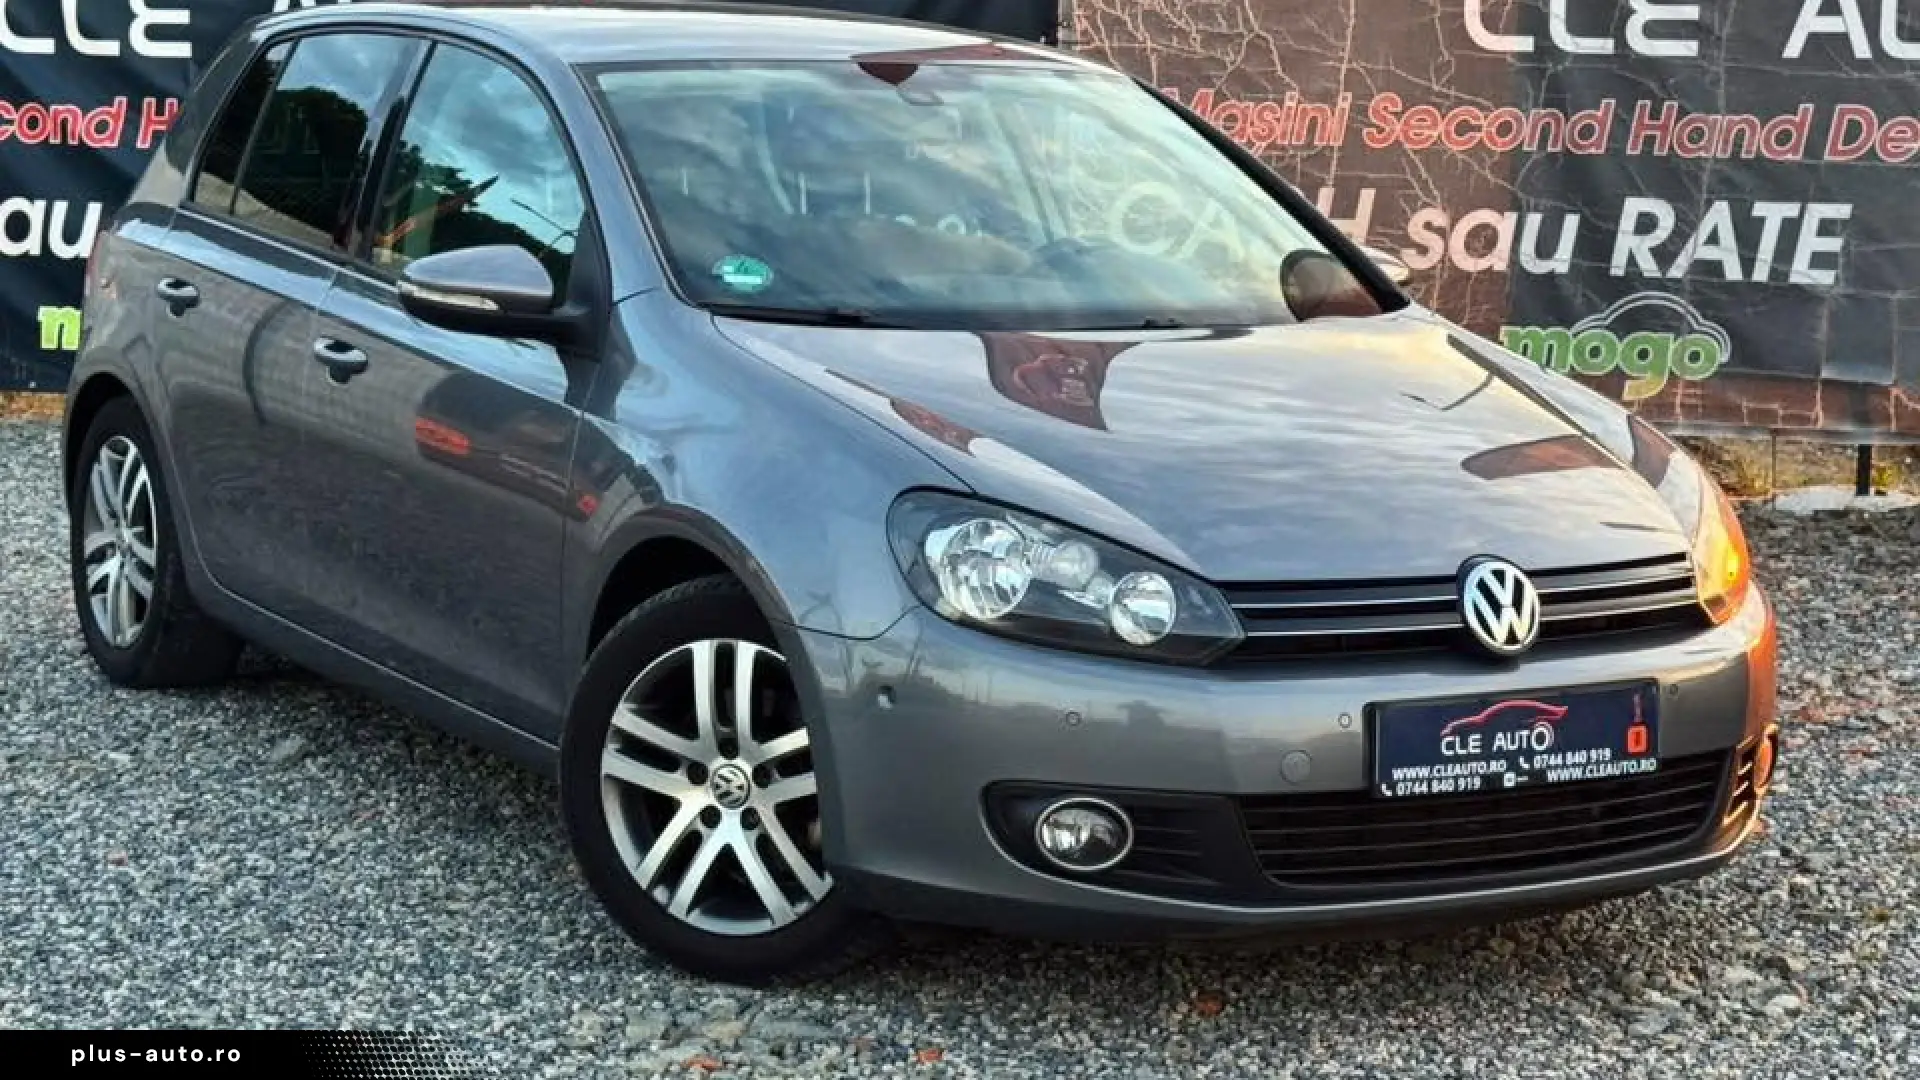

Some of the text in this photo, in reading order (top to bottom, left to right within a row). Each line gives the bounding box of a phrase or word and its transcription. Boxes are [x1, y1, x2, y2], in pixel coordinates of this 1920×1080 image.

[1464, 0, 1699, 57] CLE
[1363, 92, 1616, 155] Second
[1626, 100, 1814, 161] Hand
[1823, 103, 1920, 163] De
[0, 195, 104, 259] au
[1400, 205, 1581, 276] sau
[1608, 196, 1853, 286] RATE
[1500, 324, 1723, 402] mogo
[1463, 561, 1540, 653] VW
[1441, 726, 1552, 756] CLE AUTO
